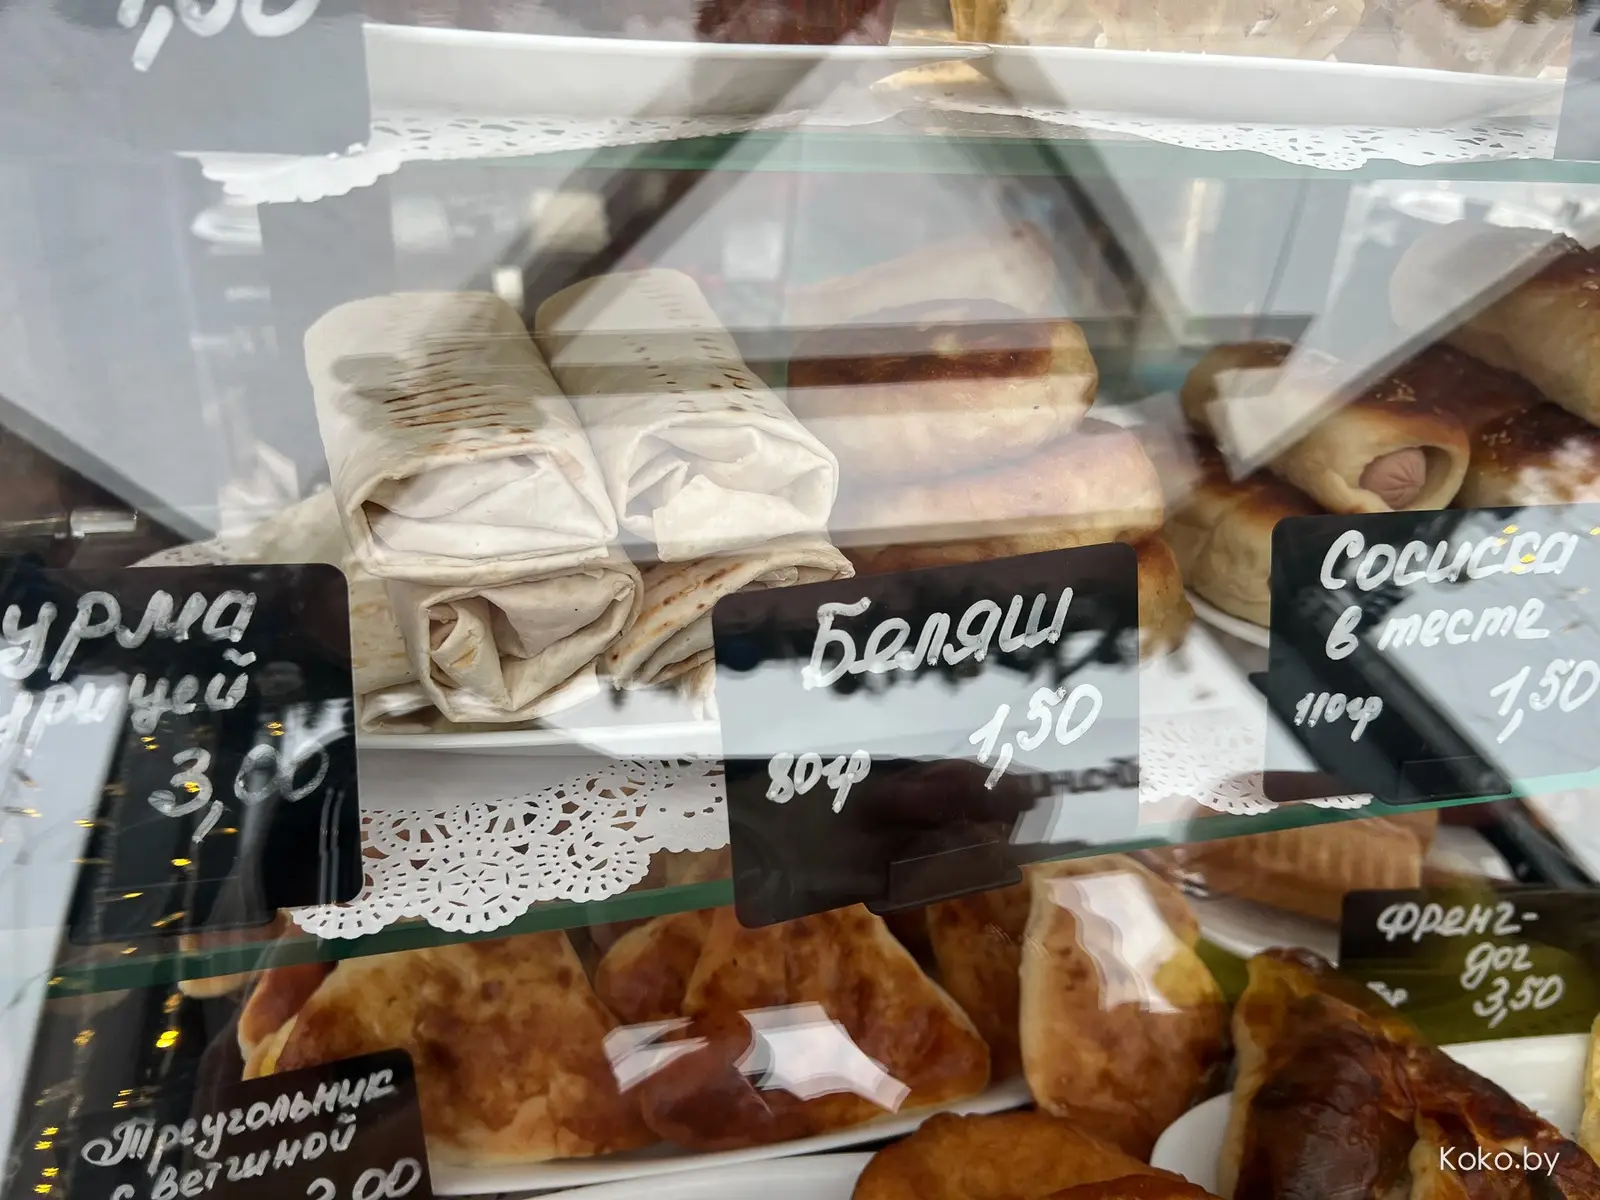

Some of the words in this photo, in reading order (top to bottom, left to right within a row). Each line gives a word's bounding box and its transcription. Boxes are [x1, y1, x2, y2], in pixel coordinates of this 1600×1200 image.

[1320, 529, 1578, 591] Сосиска
[802, 587, 1073, 690] Беляш
[1326, 605, 1362, 660] в
[1377, 597, 1550, 651] тесте
[969, 683, 1103, 790] 1,50
[1490, 658, 1600, 744] 1,50
[148, 743, 330, 843] 3,00
[1461, 942, 1533, 990] дог
[1473, 975, 1564, 1028] 3,50
[81, 1069, 395, 1176] Треугольник
